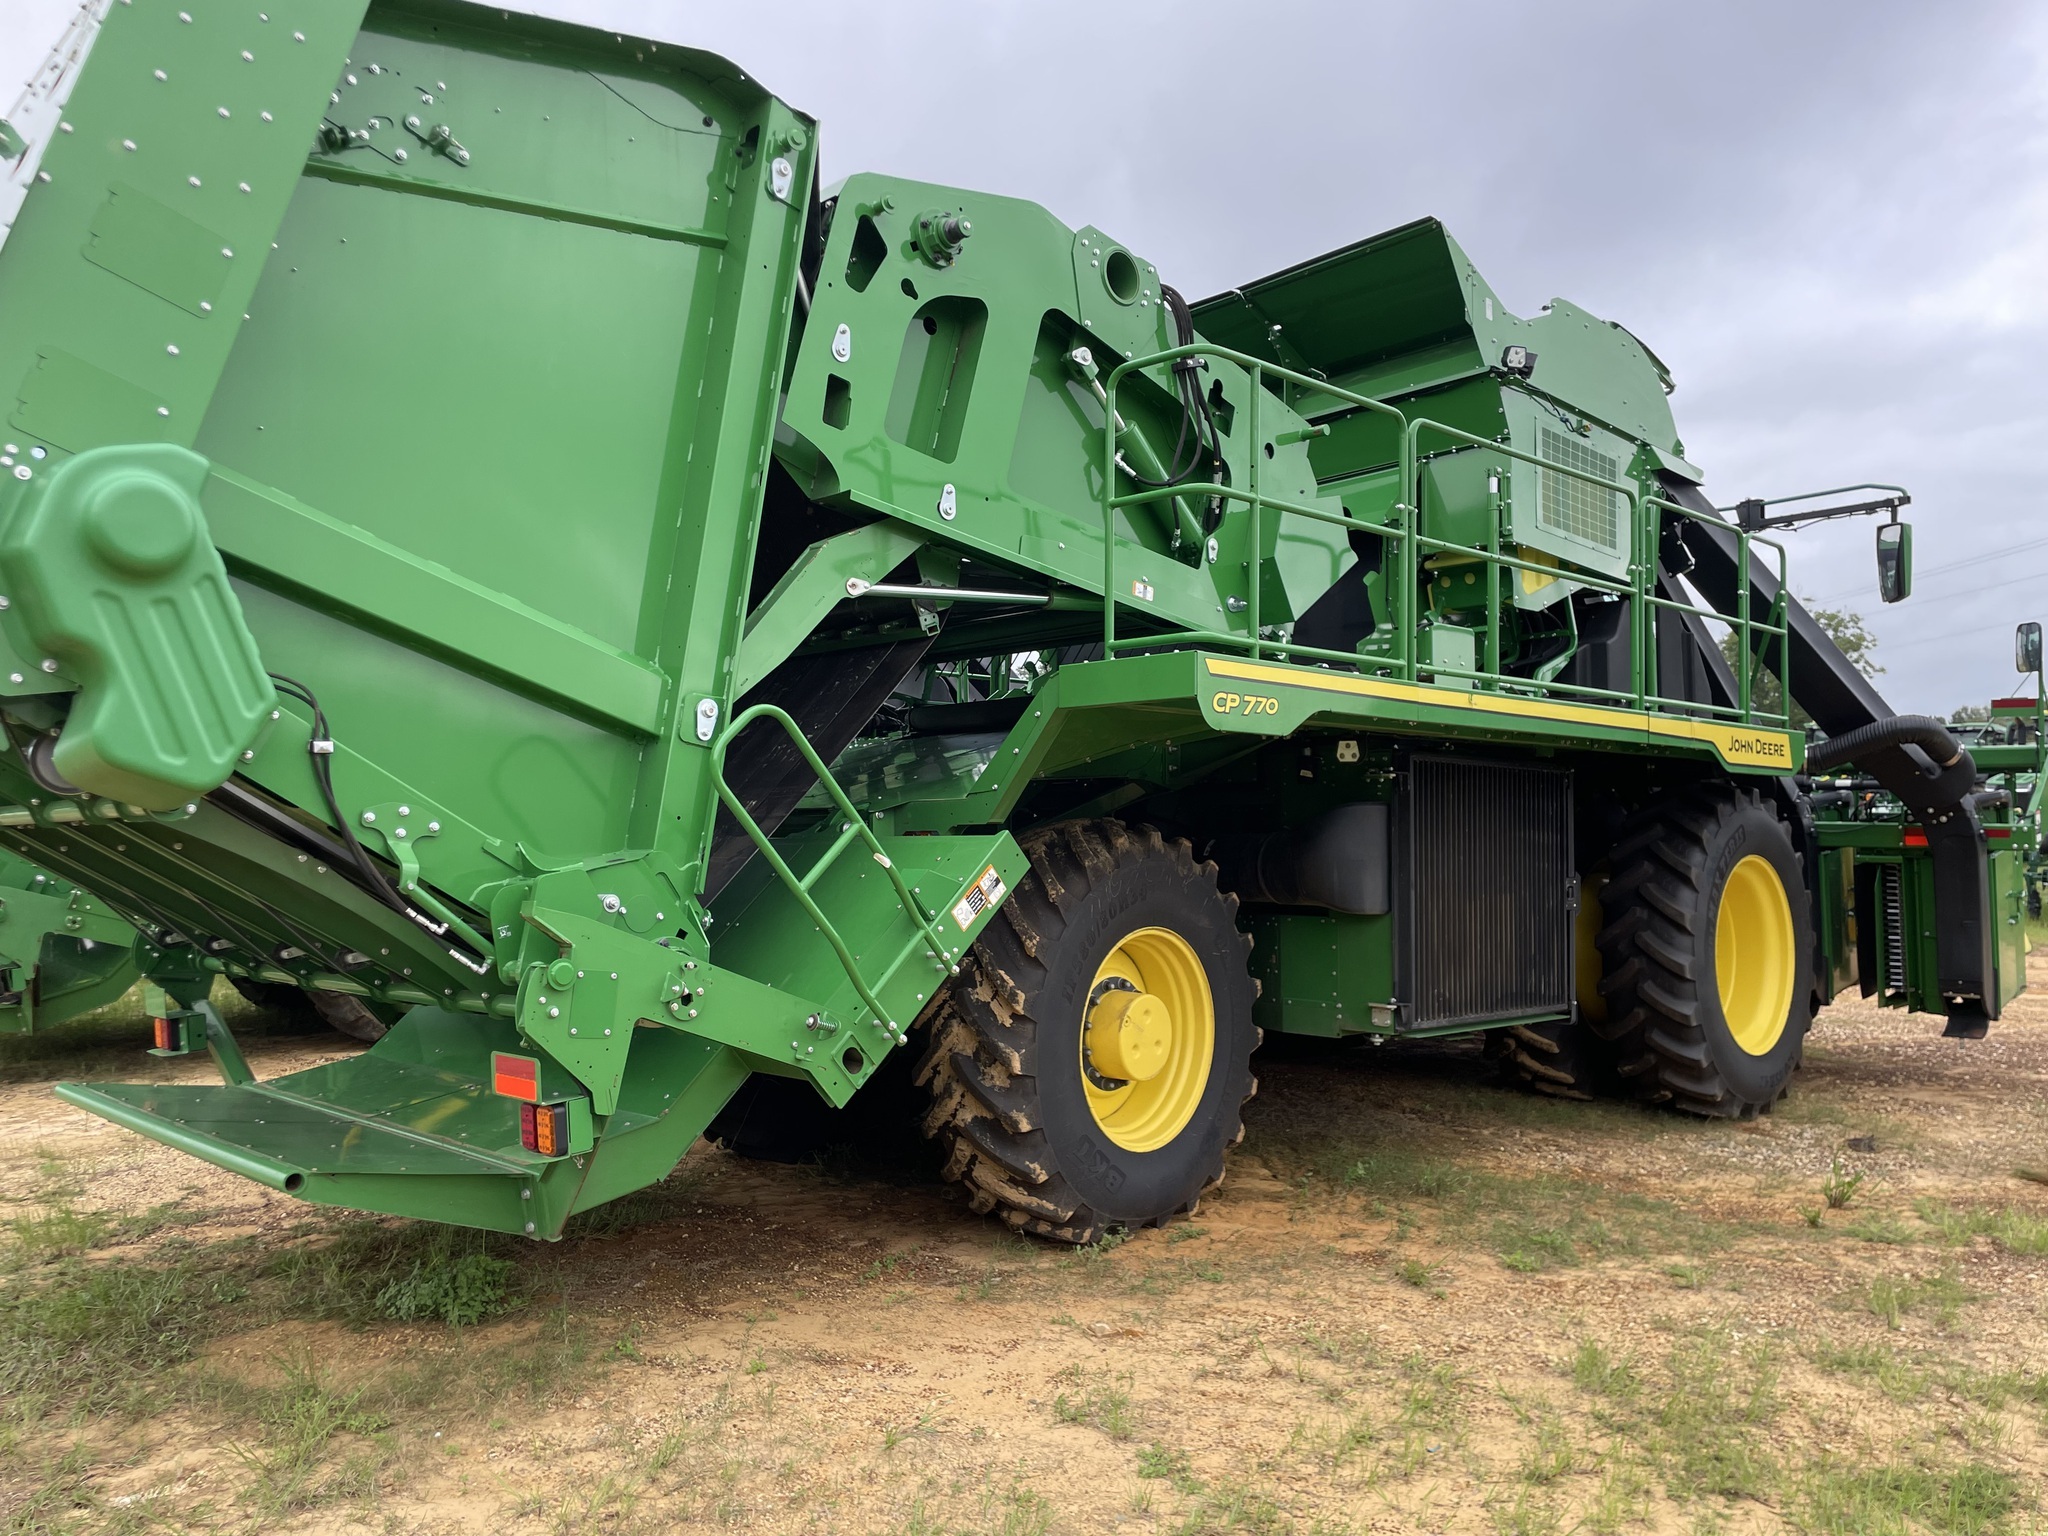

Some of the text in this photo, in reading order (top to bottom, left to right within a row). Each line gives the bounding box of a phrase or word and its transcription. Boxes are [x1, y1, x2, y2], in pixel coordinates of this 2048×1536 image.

[1212, 691, 1279, 716] CP 770
[1728, 735, 1785, 757] JOHN DEERE
[1074, 1134, 1127, 1195] BKT
